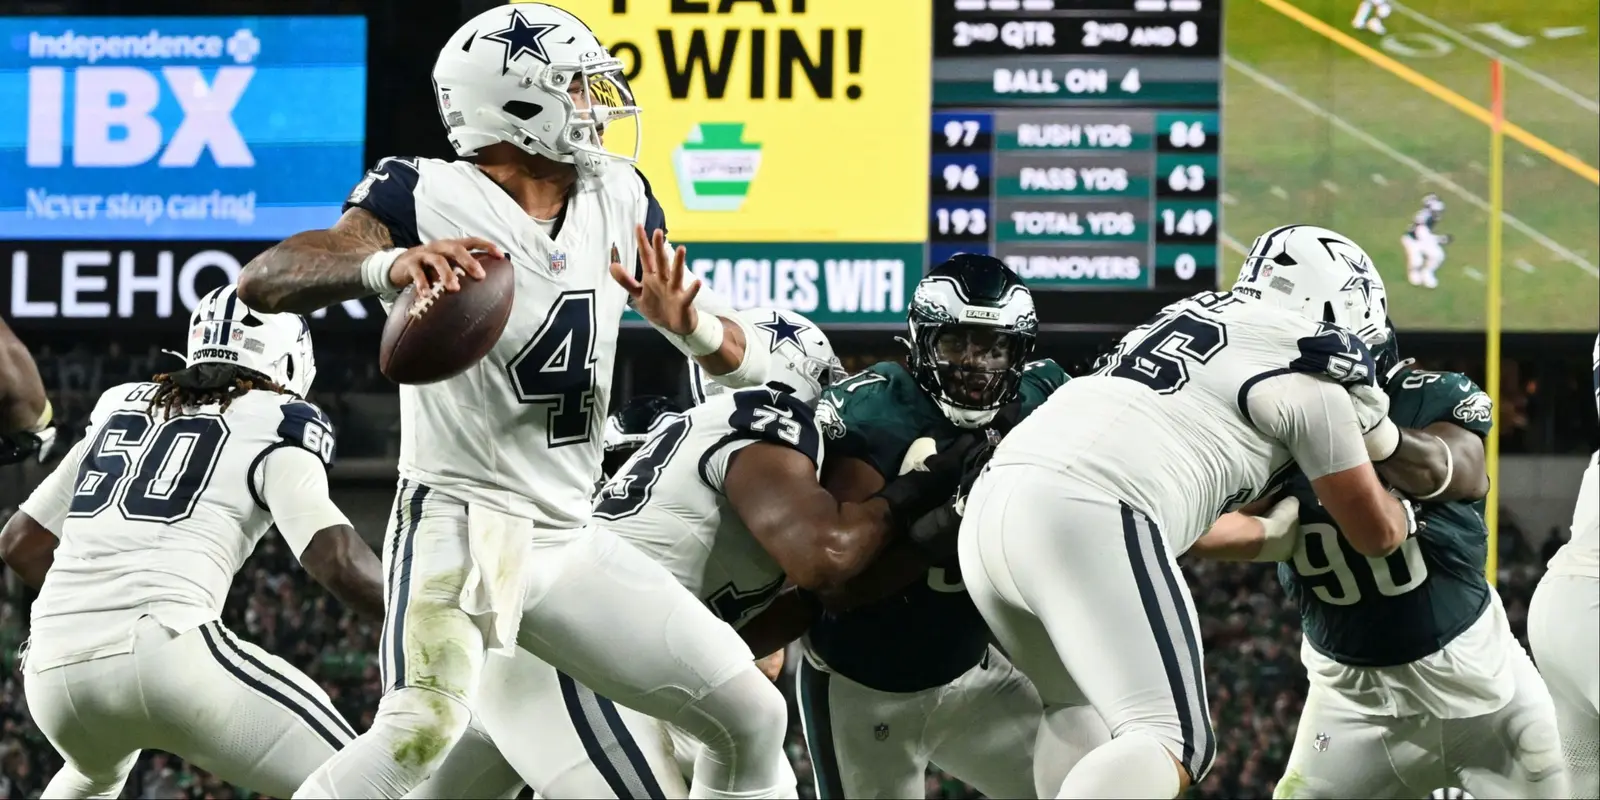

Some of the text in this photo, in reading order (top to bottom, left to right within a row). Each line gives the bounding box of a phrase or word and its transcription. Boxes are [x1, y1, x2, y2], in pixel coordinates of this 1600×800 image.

[28, 29, 224, 63] Independence
[1001, 21, 1056, 49] QTR
[1130, 27, 1176, 47] AND
[656, 28, 864, 100] WIN!
[993, 67, 1141, 93] BALL ON 4
[26, 66, 256, 168] IBX
[943, 120, 1205, 147] 97 RUSH YDS 86
[943, 164, 1205, 191] 96 PASS YDS 63
[26, 187, 256, 226] Never stop caring
[936, 208, 1213, 236] 193 TOTAL YDS 149
[823, 258, 906, 313] WIFI
[1004, 253, 1197, 280] TURNOVERS 0
[966, 310, 1000, 320] EAGLES
[193, 348, 239, 361] COWBOYS
[506, 288, 598, 449] 4
[1092, 308, 1229, 395] 6
[302, 421, 336, 465] 60
[750, 408, 802, 446] 73
[66, 409, 232, 525] 60
[591, 412, 694, 522] 3
[1293, 522, 1429, 607] 90
